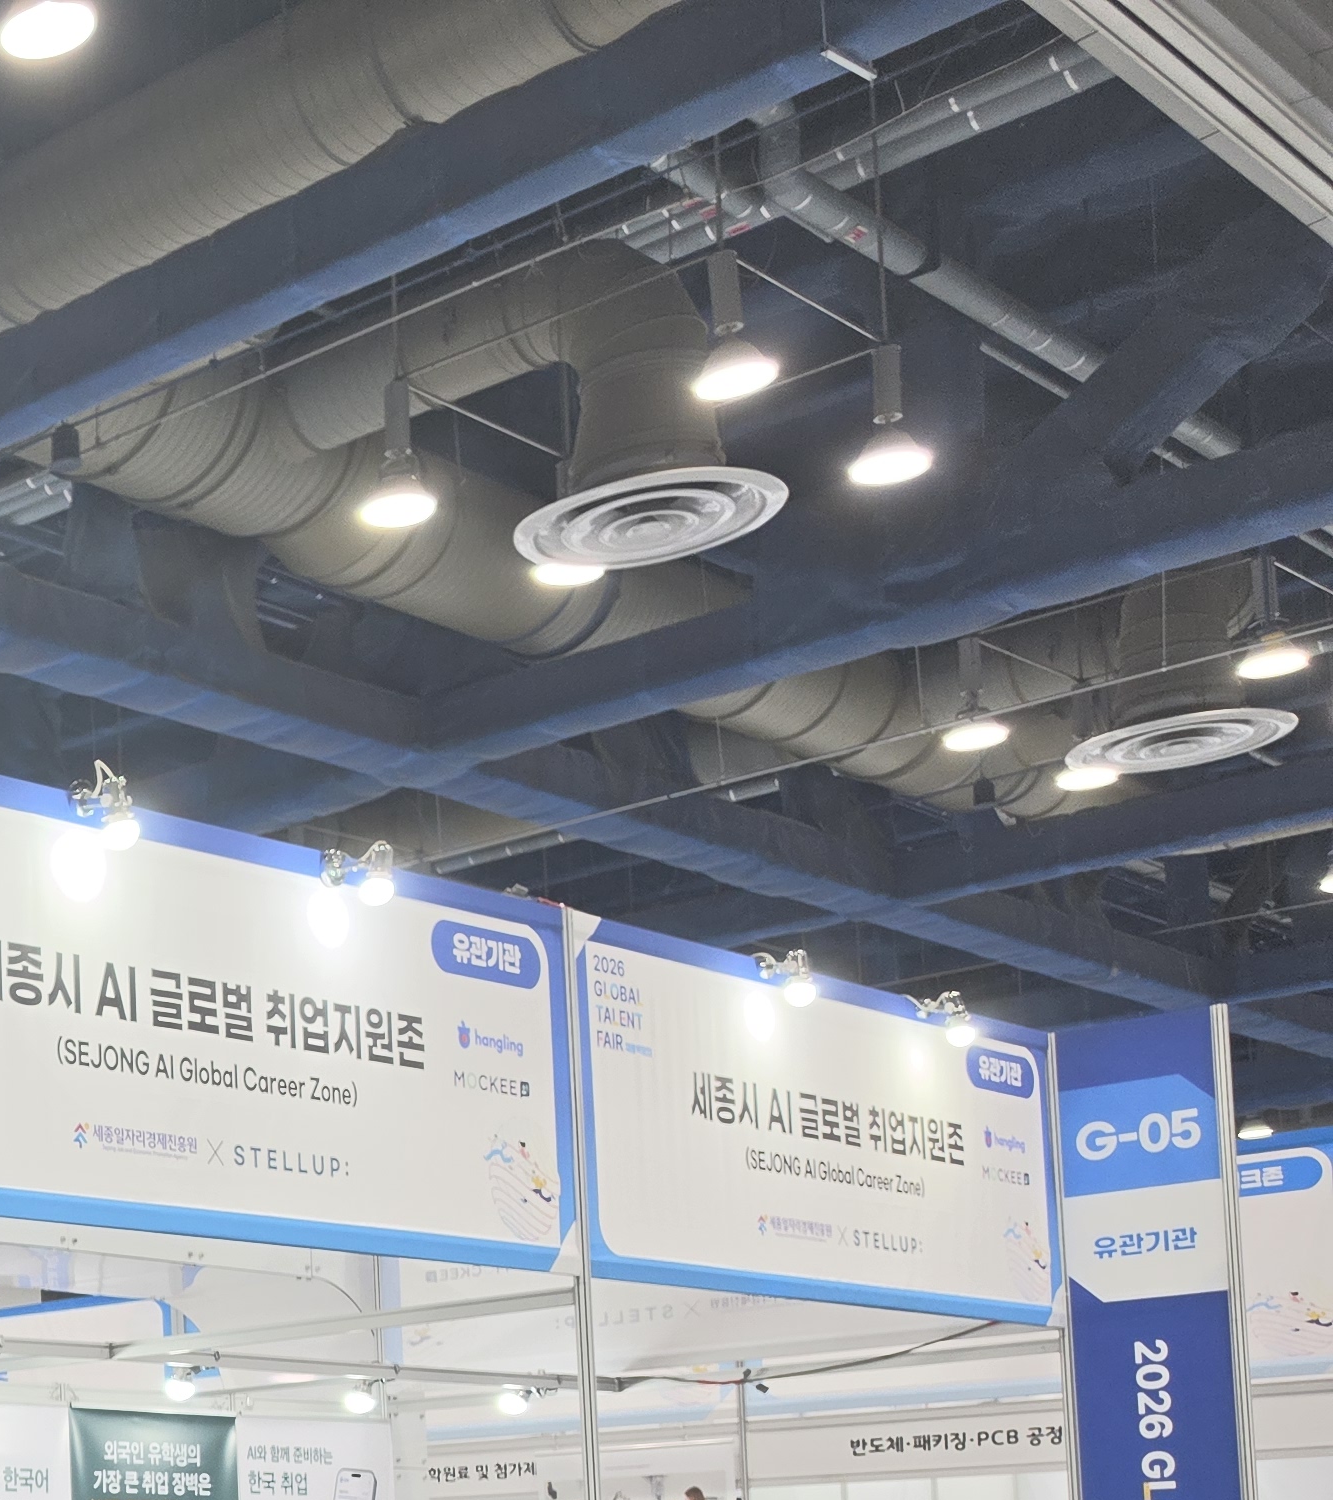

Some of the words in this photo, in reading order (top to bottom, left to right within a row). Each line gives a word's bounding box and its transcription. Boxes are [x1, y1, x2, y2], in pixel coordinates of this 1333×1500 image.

[452, 933, 521, 974] 유관기관
[593, 955, 625, 977] 2026
[594, 980, 644, 1007] GLOBAL
[96, 962, 137, 1021] AI
[150, 968, 253, 1043] 글로벌
[266, 989, 425, 1070] 취업지원존
[595, 1005, 643, 1030] TALENT
[474, 1027, 524, 1057] hangling
[596, 1030, 624, 1051] FAIR
[56, 1036, 150, 1078] (SEJONG
[155, 1049, 174, 1077] AI
[180, 1056, 237, 1089] Global
[243, 1067, 305, 1098] Career
[310, 1076, 358, 1107] Zone)
[978, 1055, 1022, 1087] 유관기관
[690, 1070, 759, 1130] 세종시
[767, 1090, 792, 1135] AI
[799, 1097, 861, 1149] 글로벌
[867, 1107, 965, 1168] 취업지원존
[1075, 1107, 1202, 1163] G-05
[93, 1124, 197, 1154] 세종일자리경제진흥원
[234, 1145, 349, 1177] STELLUP:
[745, 1145, 801, 1177] (SEJONG
[804, 1154, 817, 1177] AI
[818, 1156, 856, 1186] Global
[857, 1162, 894, 1191] Career
[895, 1171, 925, 1199] Zone)
[1237, 1165, 1284, 1190] 크존
[853, 1229, 923, 1254] STELLUP:
[1092, 1227, 1198, 1261] 유관기관
[1133, 1339, 1173, 1439] 2026
[103, 1441, 144, 1466] 외국인
[147, 1442, 201, 1468] 유학생의
[247, 1445, 267, 1463] AI와
[270, 1445, 290, 1463] 함께
[293, 1446, 333, 1465] 준비하는
[849, 1428, 1020, 1458] 반도체·패키징·PCB
[1026, 1424, 1064, 1449] 공정
[2, 1468, 50, 1495] 한국어
[93, 1470, 121, 1495] 가장
[124, 1471, 140, 1495] 큰
[141, 1471, 169, 1495] 취업
[172, 1472, 212, 1497] 장벽은
[248, 1470, 276, 1496] 한국
[281, 1471, 308, 1496] 취업
[428, 1465, 470, 1483] 학원료
[475, 1463, 489, 1480] 및
[494, 1461, 537, 1480] 첨가제
